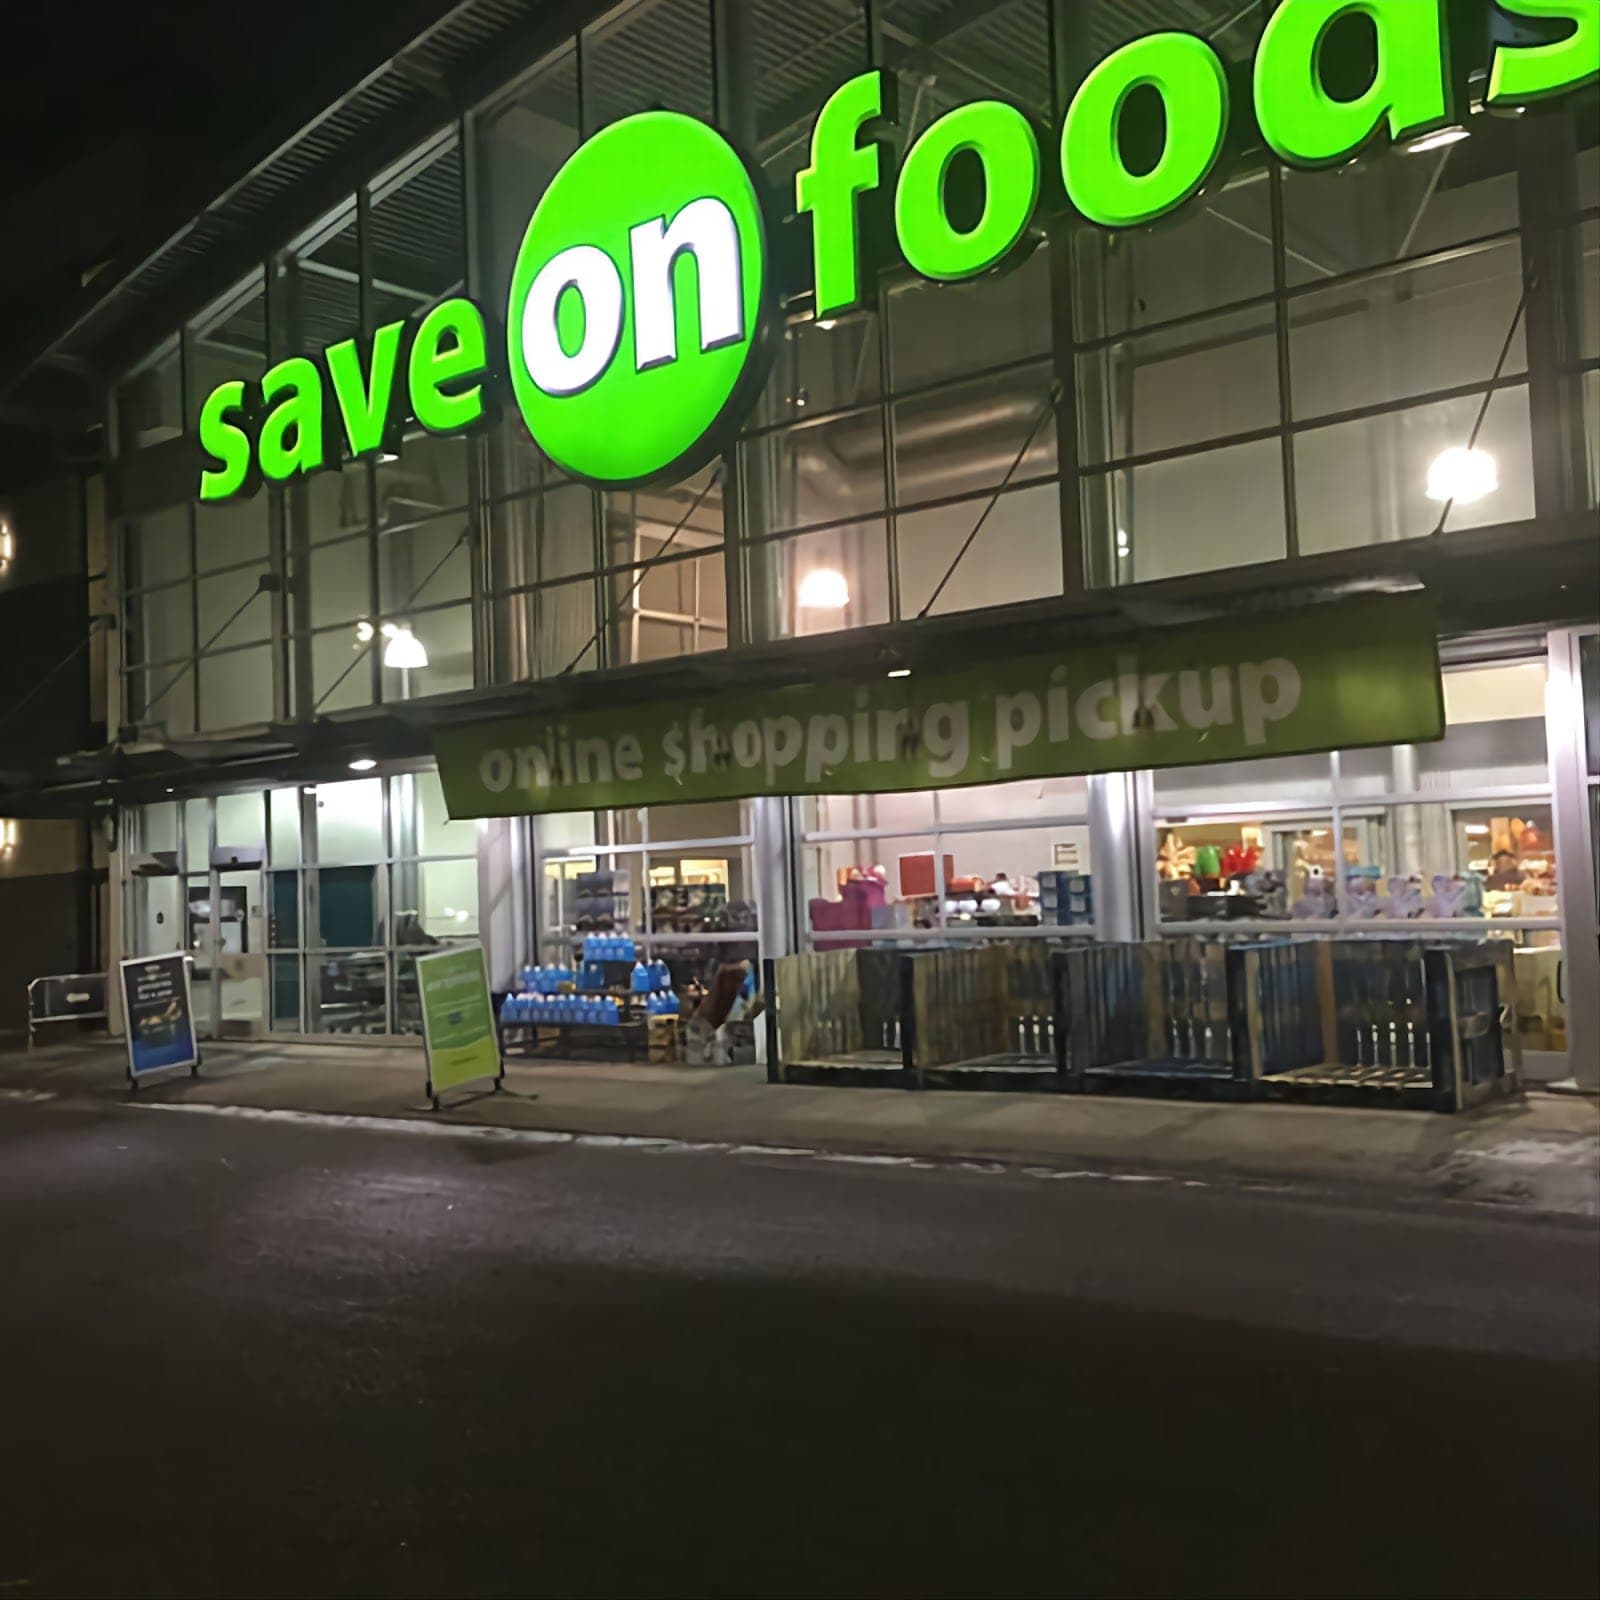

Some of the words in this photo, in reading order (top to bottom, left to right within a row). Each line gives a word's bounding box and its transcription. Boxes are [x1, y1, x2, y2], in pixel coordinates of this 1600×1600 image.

[199, 298, 486, 500] save
[521, 197, 746, 397] on
[479, 723, 644, 793] online
[662, 685, 970, 786] shopping
[995, 655, 1301, 769] pickup
